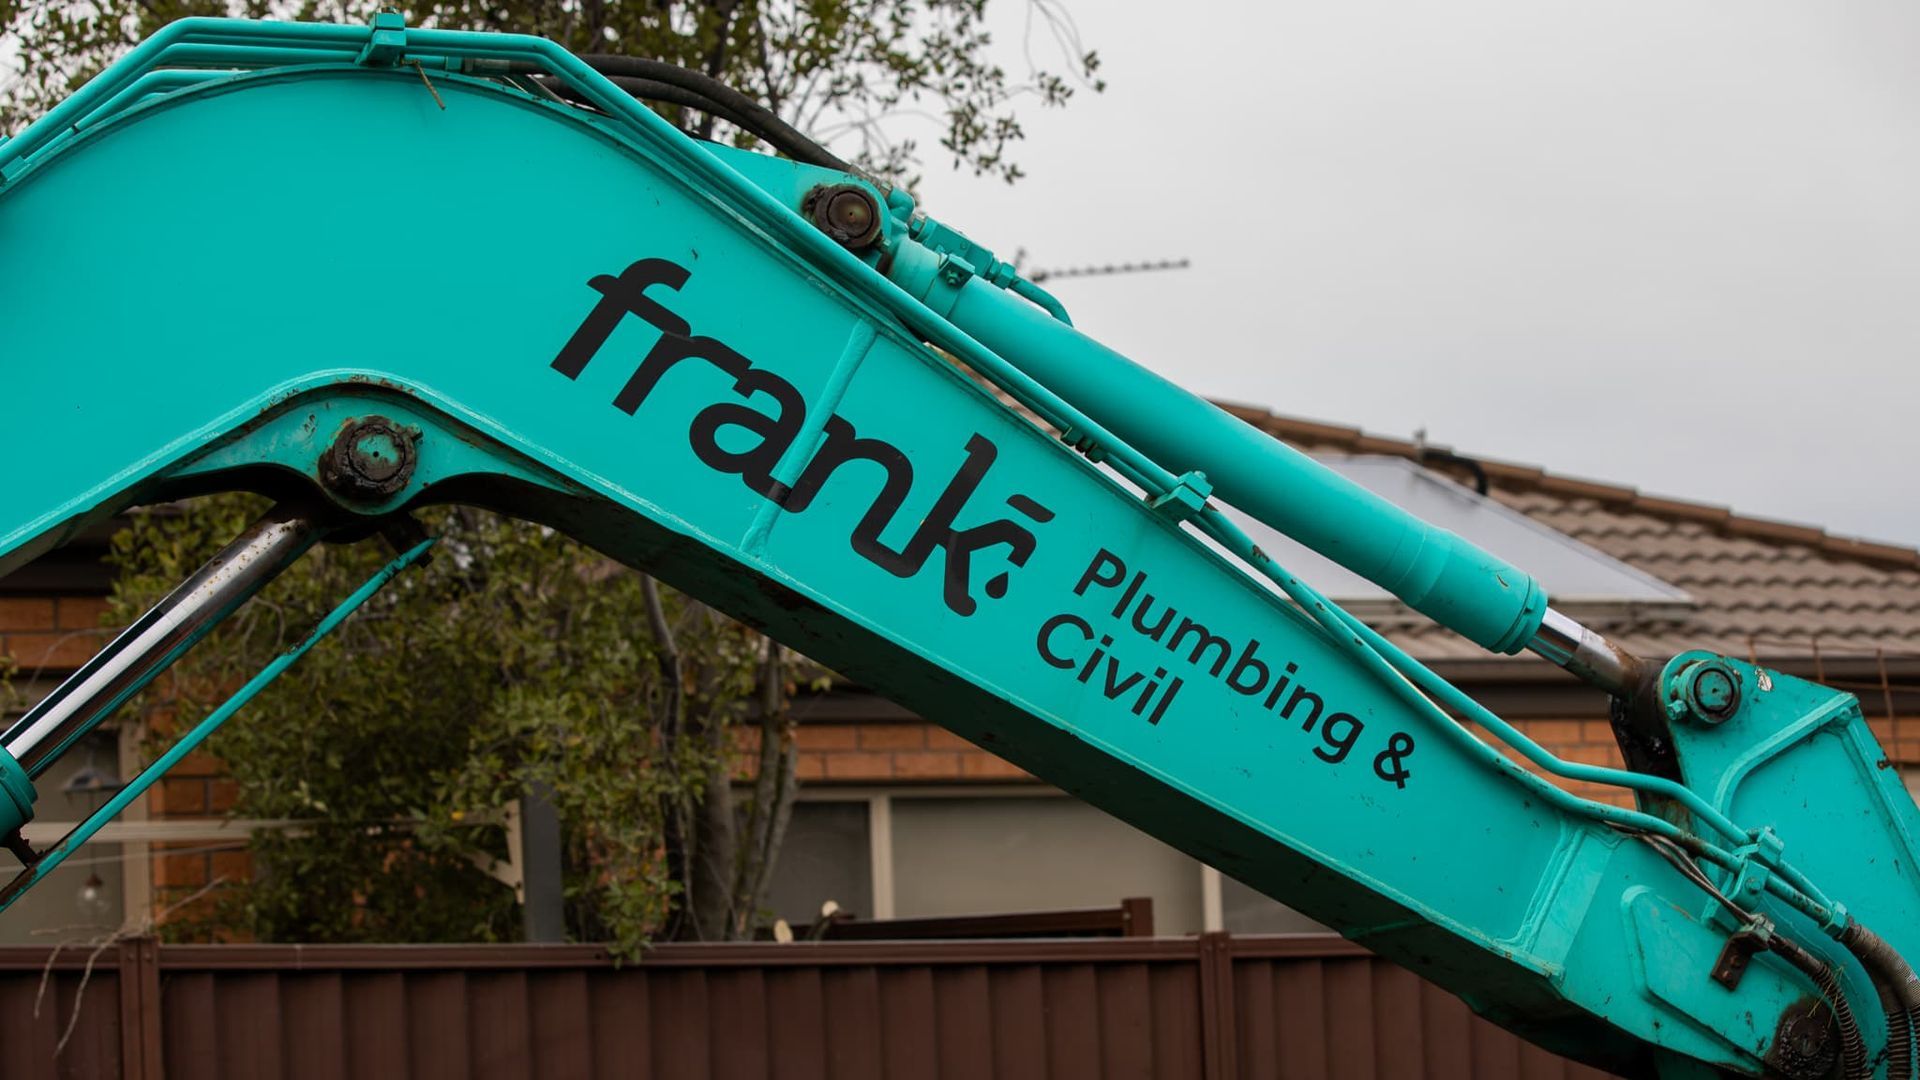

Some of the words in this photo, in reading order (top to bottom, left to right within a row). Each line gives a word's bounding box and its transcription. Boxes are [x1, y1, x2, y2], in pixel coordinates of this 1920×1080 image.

[550, 257, 1055, 617] frank
[1036, 613, 1184, 726] Civil
[1072, 547, 1365, 764] Plumbing
[1373, 731, 1415, 790] &
